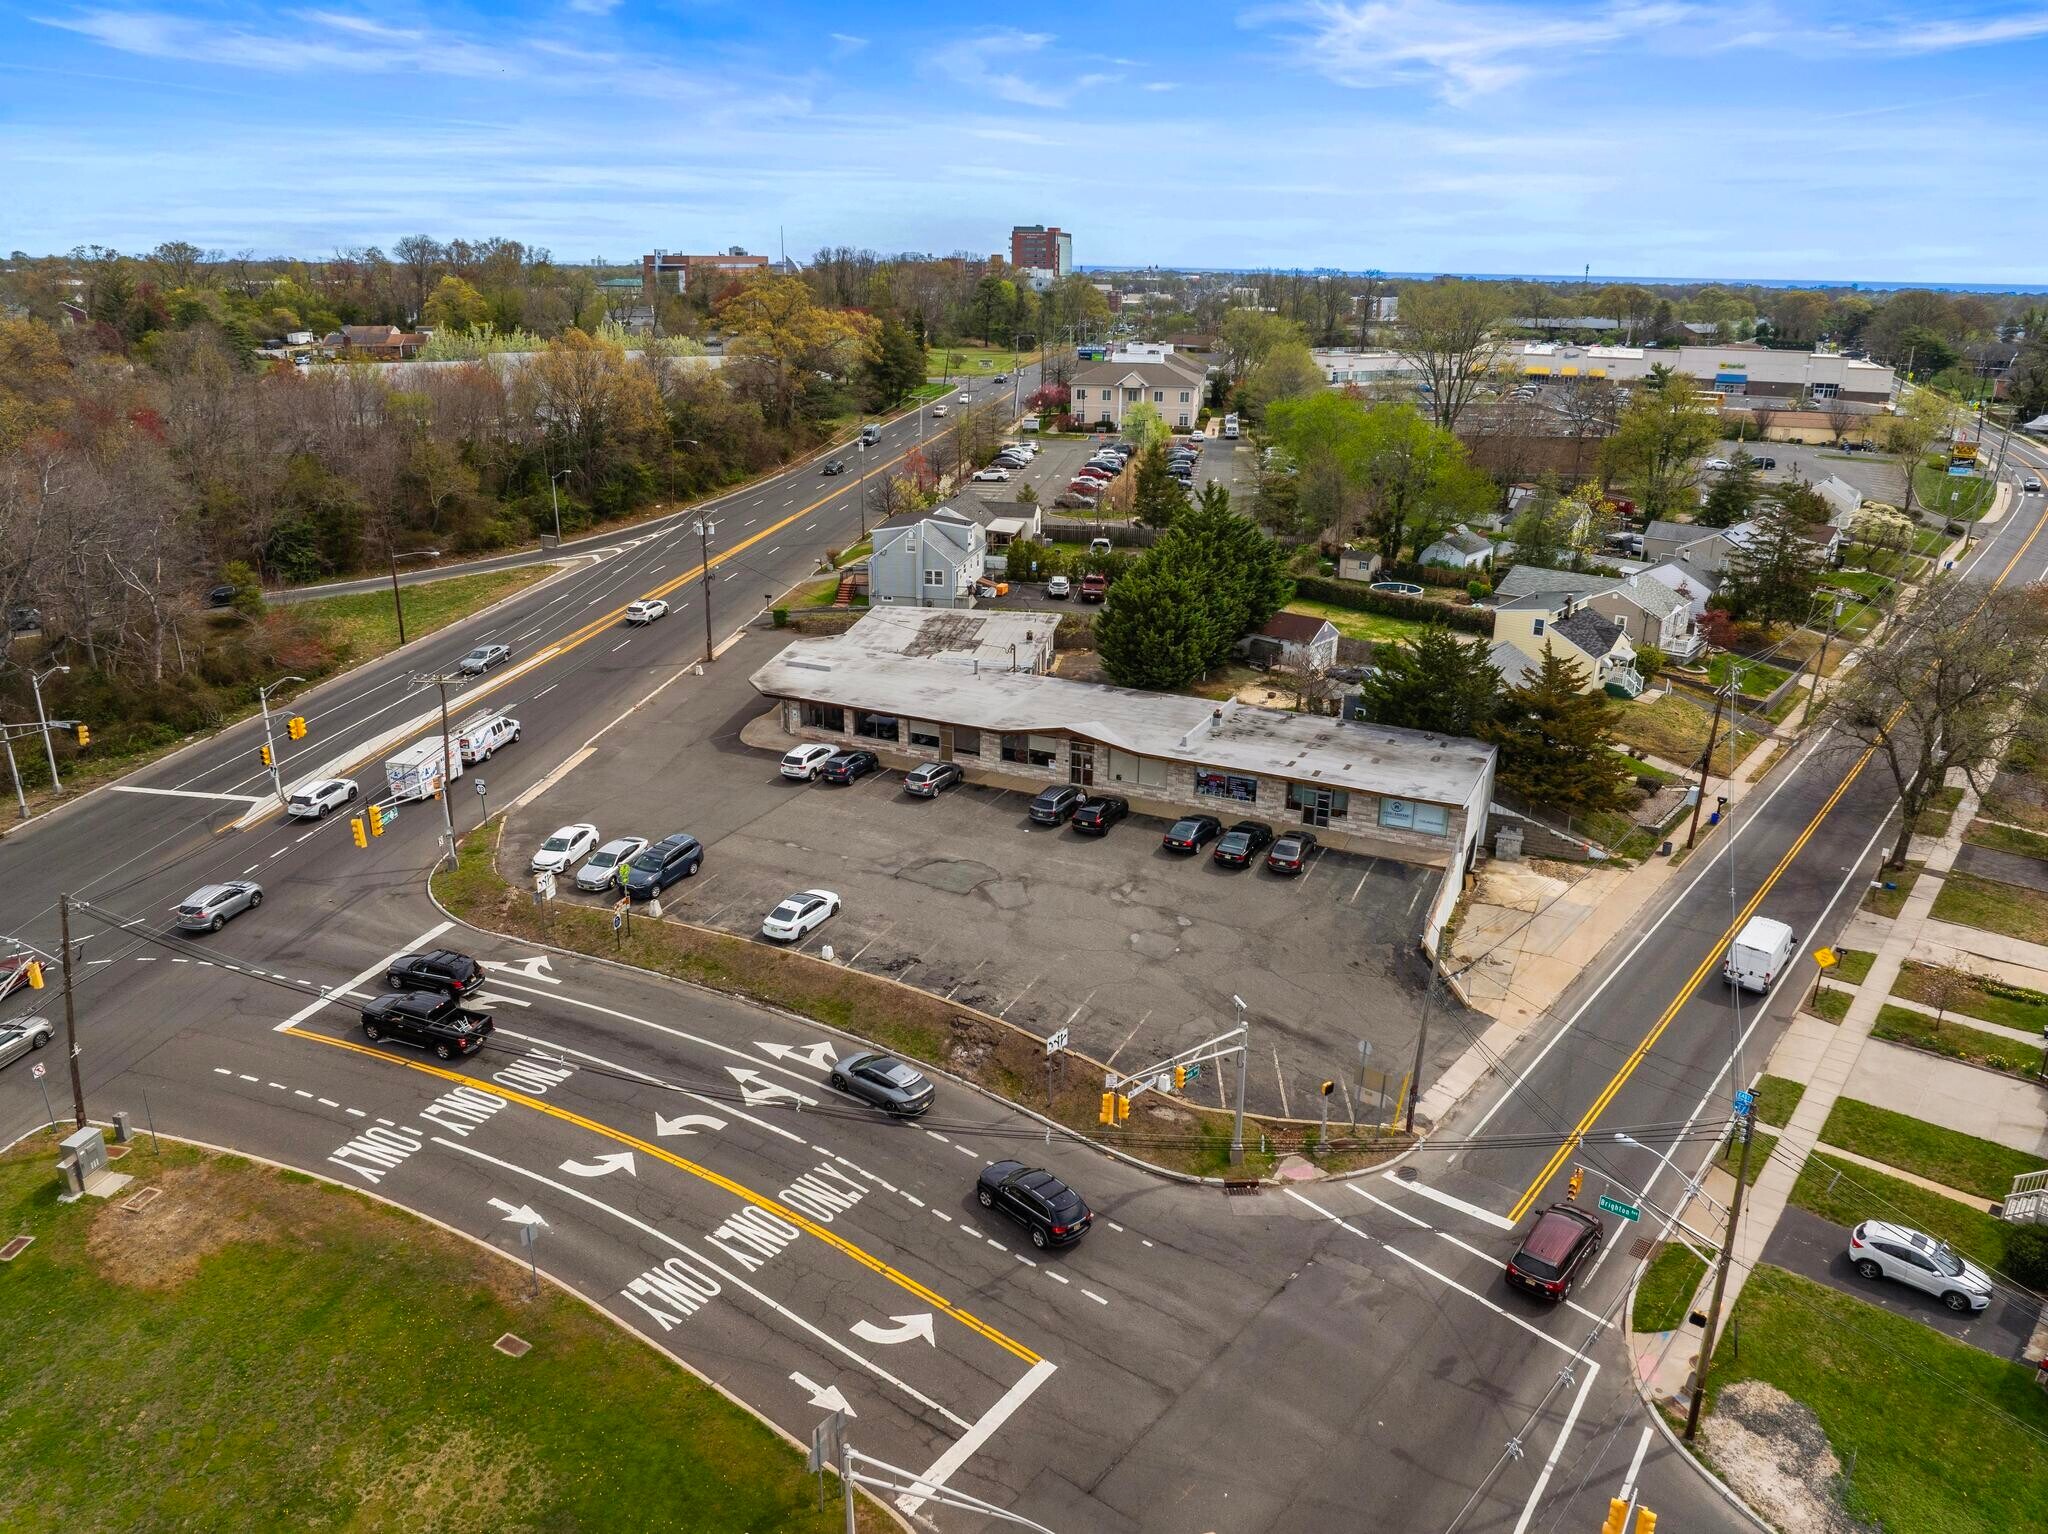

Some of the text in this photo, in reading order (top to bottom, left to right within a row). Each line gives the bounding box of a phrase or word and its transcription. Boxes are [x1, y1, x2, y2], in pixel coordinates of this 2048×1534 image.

[493, 1048, 580, 1095] ONLY
[419, 1086, 508, 1137] ONLY
[327, 1126, 422, 1184] ONLY
[778, 1162, 870, 1223] ONLY
[1600, 1199, 1630, 1215] Brighton
[704, 1205, 800, 1273] ONLY
[620, 1257, 722, 1332] ONLY
